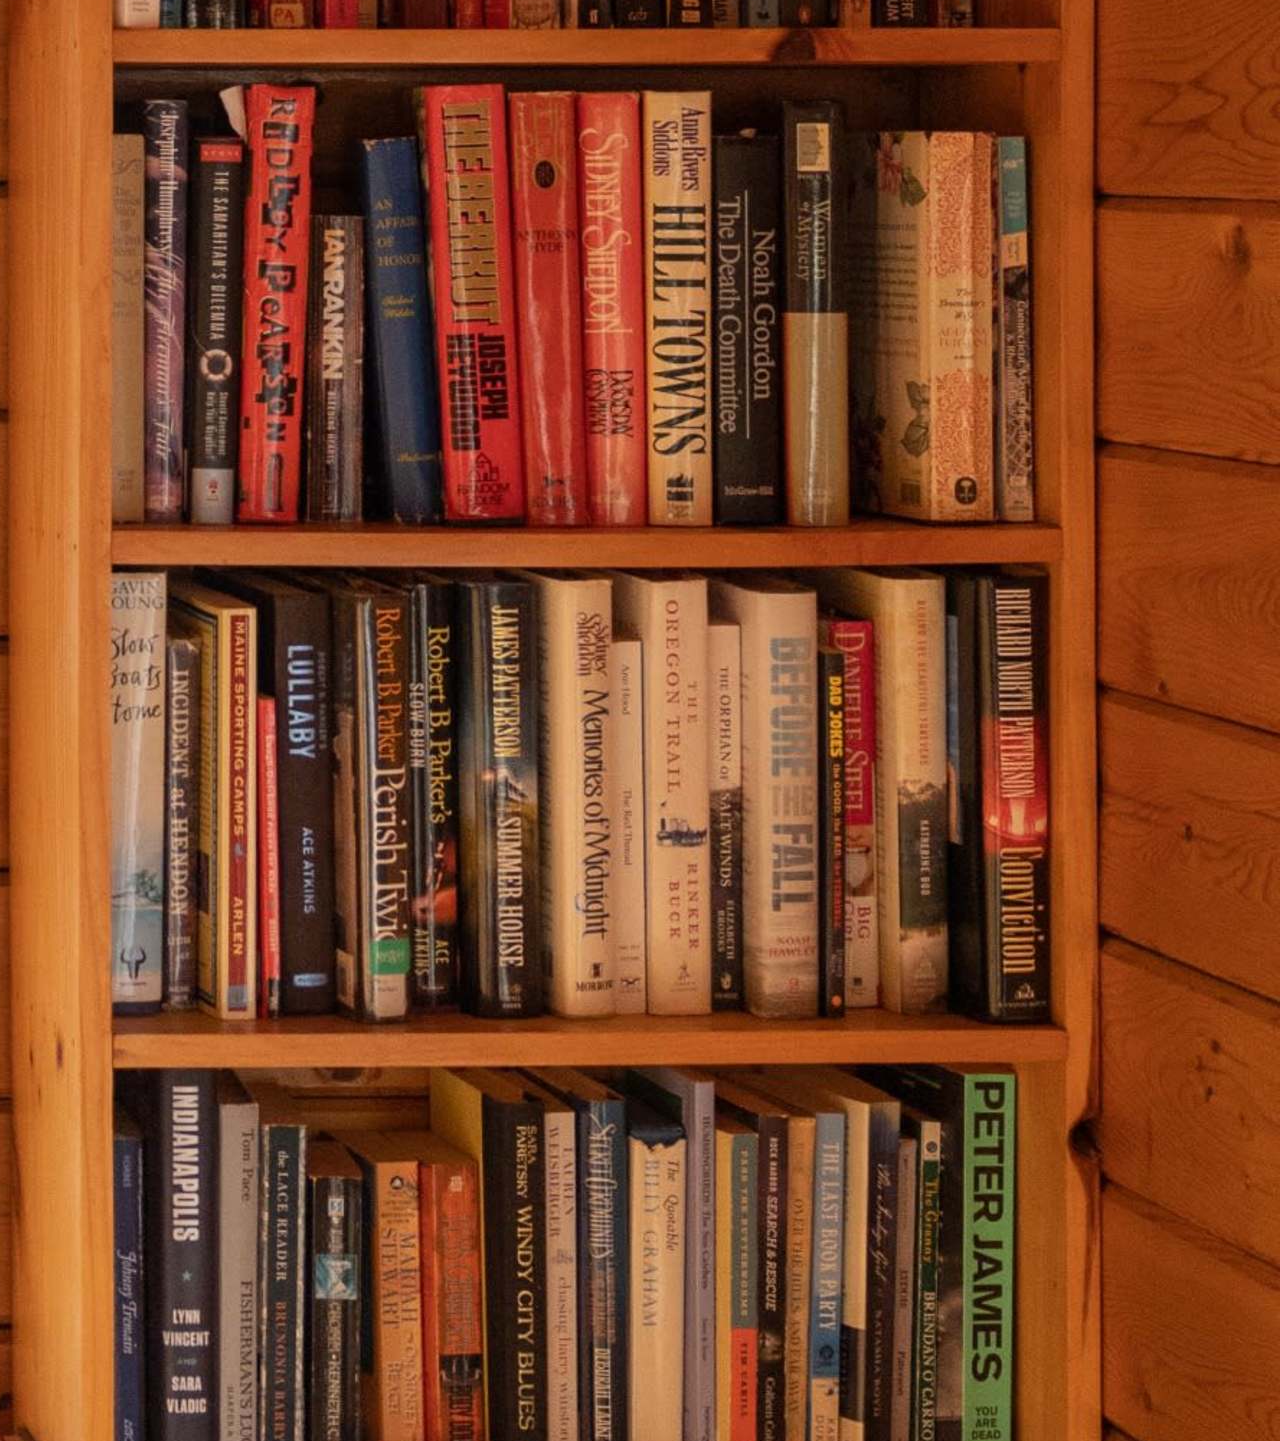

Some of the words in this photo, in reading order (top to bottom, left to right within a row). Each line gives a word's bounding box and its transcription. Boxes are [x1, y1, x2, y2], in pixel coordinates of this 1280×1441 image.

[652, 203, 706, 300] HILL
[718, 196, 740, 238] The
[718, 241, 740, 311] Death
[753, 228, 776, 294] Noah
[652, 310, 706, 456] TOWNS
[718, 316, 741, 434] Committee
[753, 301, 776, 401] Gordon
[493, 605, 520, 667] JAMES
[288, 644, 316, 759] LULLABY
[494, 669, 522, 759] PATTERSON
[496, 816, 523, 897] SUMMER
[498, 900, 524, 968] HOUSE
[1000, 845, 1045, 974] Conviction
[172, 1085, 199, 1243] INDIANAPOLIS
[972, 1081, 1005, 1223] PETER
[516, 1205, 535, 1283] WINDY
[163, 1331, 210, 1346] VINCENT
[173, 1310, 201, 1324] LYNN
[516, 1288, 535, 1346] CITY
[971, 1235, 1003, 1383] JAMES
[167, 1398, 207, 1414] VLADIC
[171, 1377, 202, 1391] SARA
[517, 1352, 536, 1433] BLUES
[975, 1406, 999, 1416] YOU
[971, 1430, 1001, 1440] DEAD
